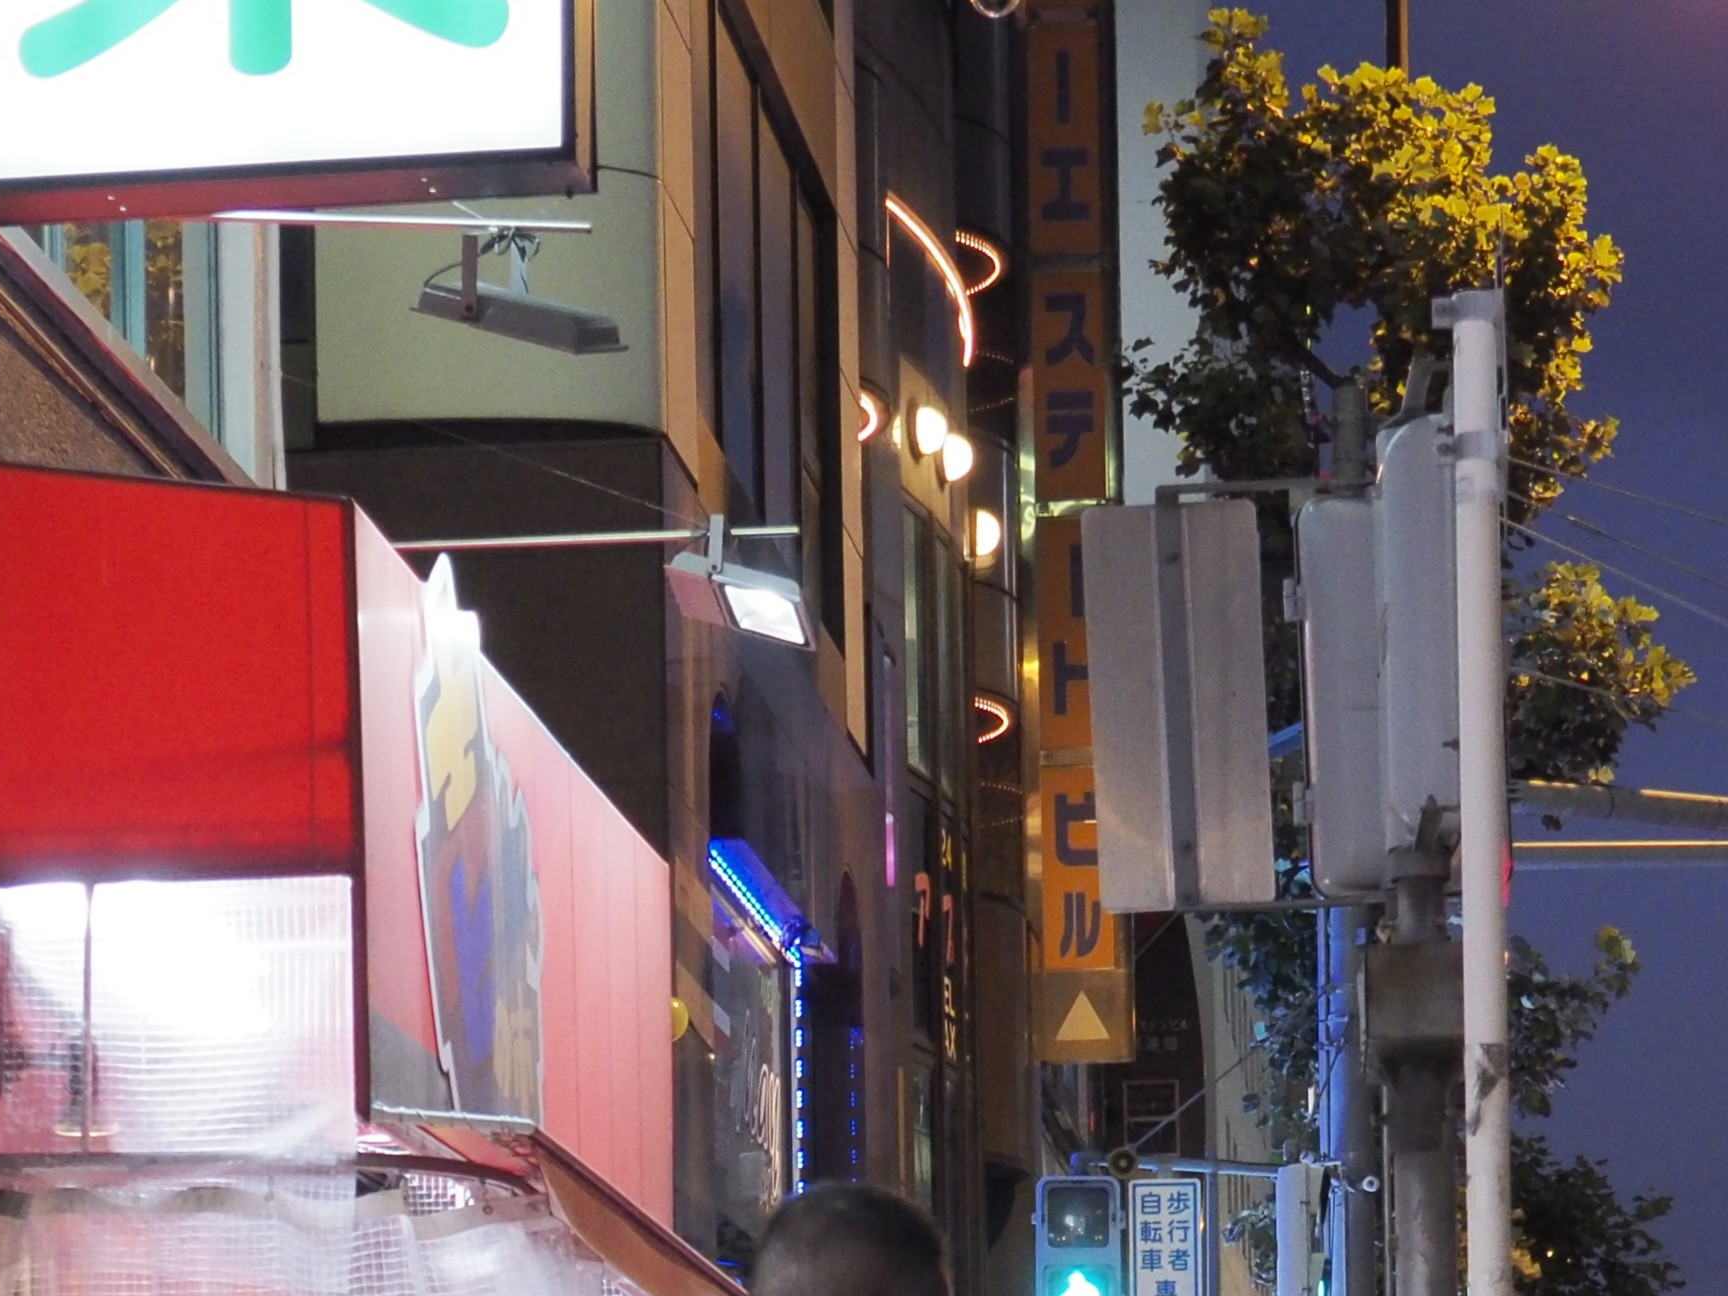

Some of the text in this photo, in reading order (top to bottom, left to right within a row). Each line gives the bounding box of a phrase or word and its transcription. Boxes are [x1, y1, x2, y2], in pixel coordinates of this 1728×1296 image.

[1140, 1191, 1163, 1272] 自転車
[1167, 1190, 1190, 1271] 歩行者
